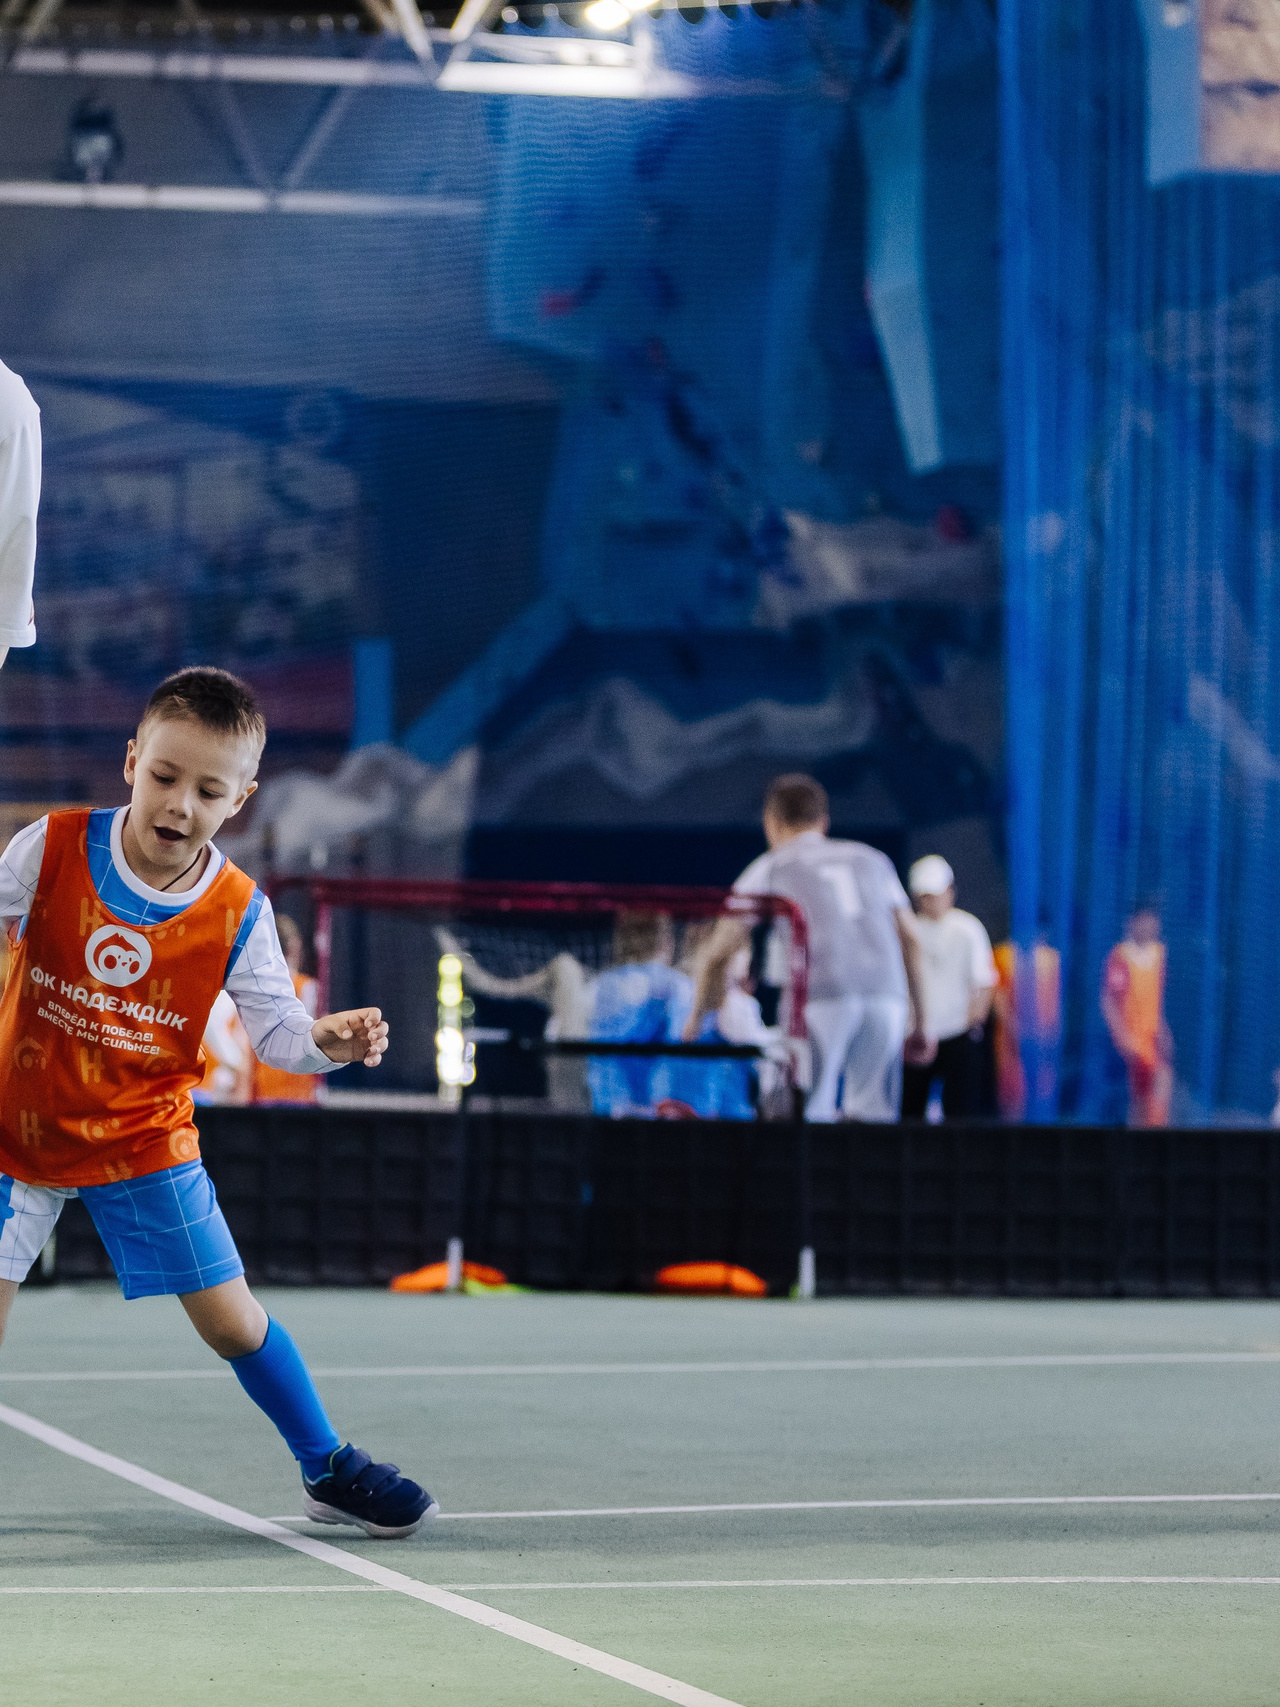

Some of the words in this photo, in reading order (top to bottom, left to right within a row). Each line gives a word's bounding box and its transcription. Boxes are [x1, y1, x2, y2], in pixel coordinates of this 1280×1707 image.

[30, 965, 58, 992] ФК
[59, 978, 190, 1032] НАДЕЖДИК
[47, 1000, 87, 1029] ВПЕРЁД
[89, 1020, 99, 1032] К
[101, 1023, 154, 1043] ПОБЕДЕ!
[36, 1006, 74, 1036] ВМЕСТЕ
[76, 1029, 99, 1043] МЫ
[101, 1035, 161, 1056] СИЛЬНЕЕ!
